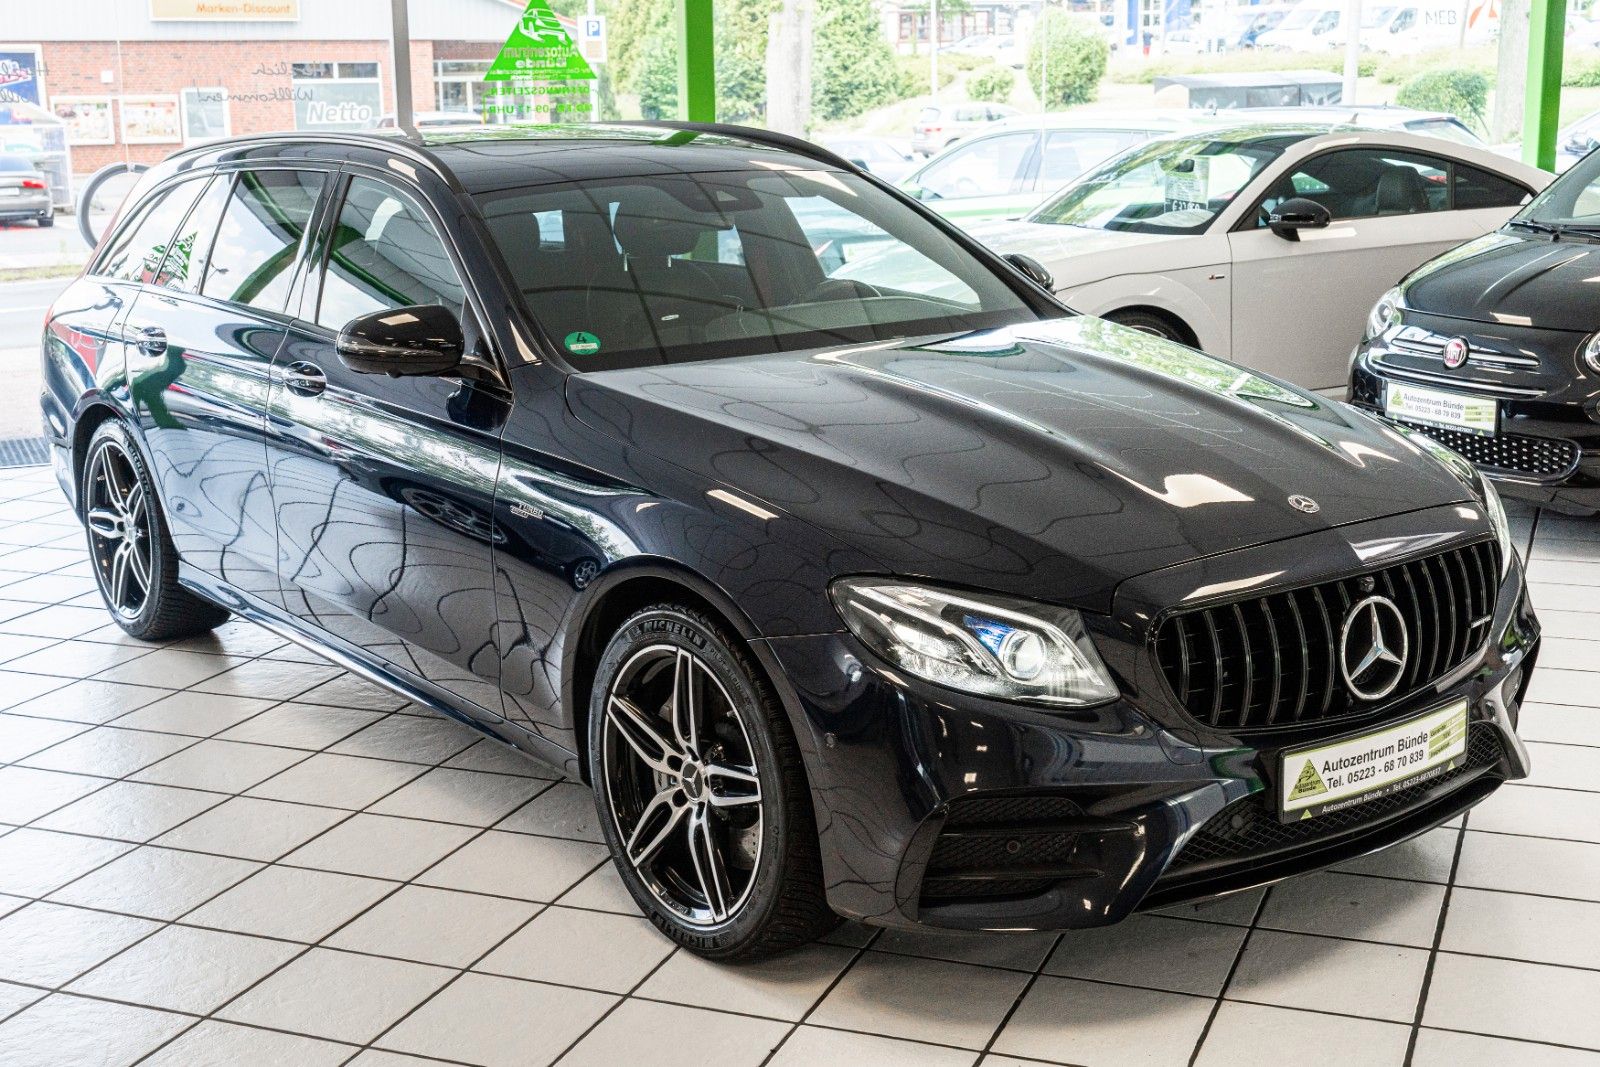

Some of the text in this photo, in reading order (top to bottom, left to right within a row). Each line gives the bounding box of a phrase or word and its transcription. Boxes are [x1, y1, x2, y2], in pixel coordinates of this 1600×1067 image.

[197, 3, 290, 13] Marken-Discount
[589, 21, 599, 36] P
[307, 102, 372, 123] Netto
[576, 333, 586, 343] 4
[1403, 393, 1464, 411] Autozentrum Bünde
[643, 620, 704, 647] MICHELIN
[1321, 742, 1395, 775] Autozentrum
[1397, 731, 1428, 753] Bünde
[1326, 773, 1345, 790] Tel.
[1347, 764, 1376, 785] 05223
[1384, 761, 1395, 776] 68
[1397, 755, 1408, 770] 70
[1409, 749, 1424, 765] 839
[1321, 796, 1363, 814] Autozentrum
[1363, 790, 1383, 803] Bünde
